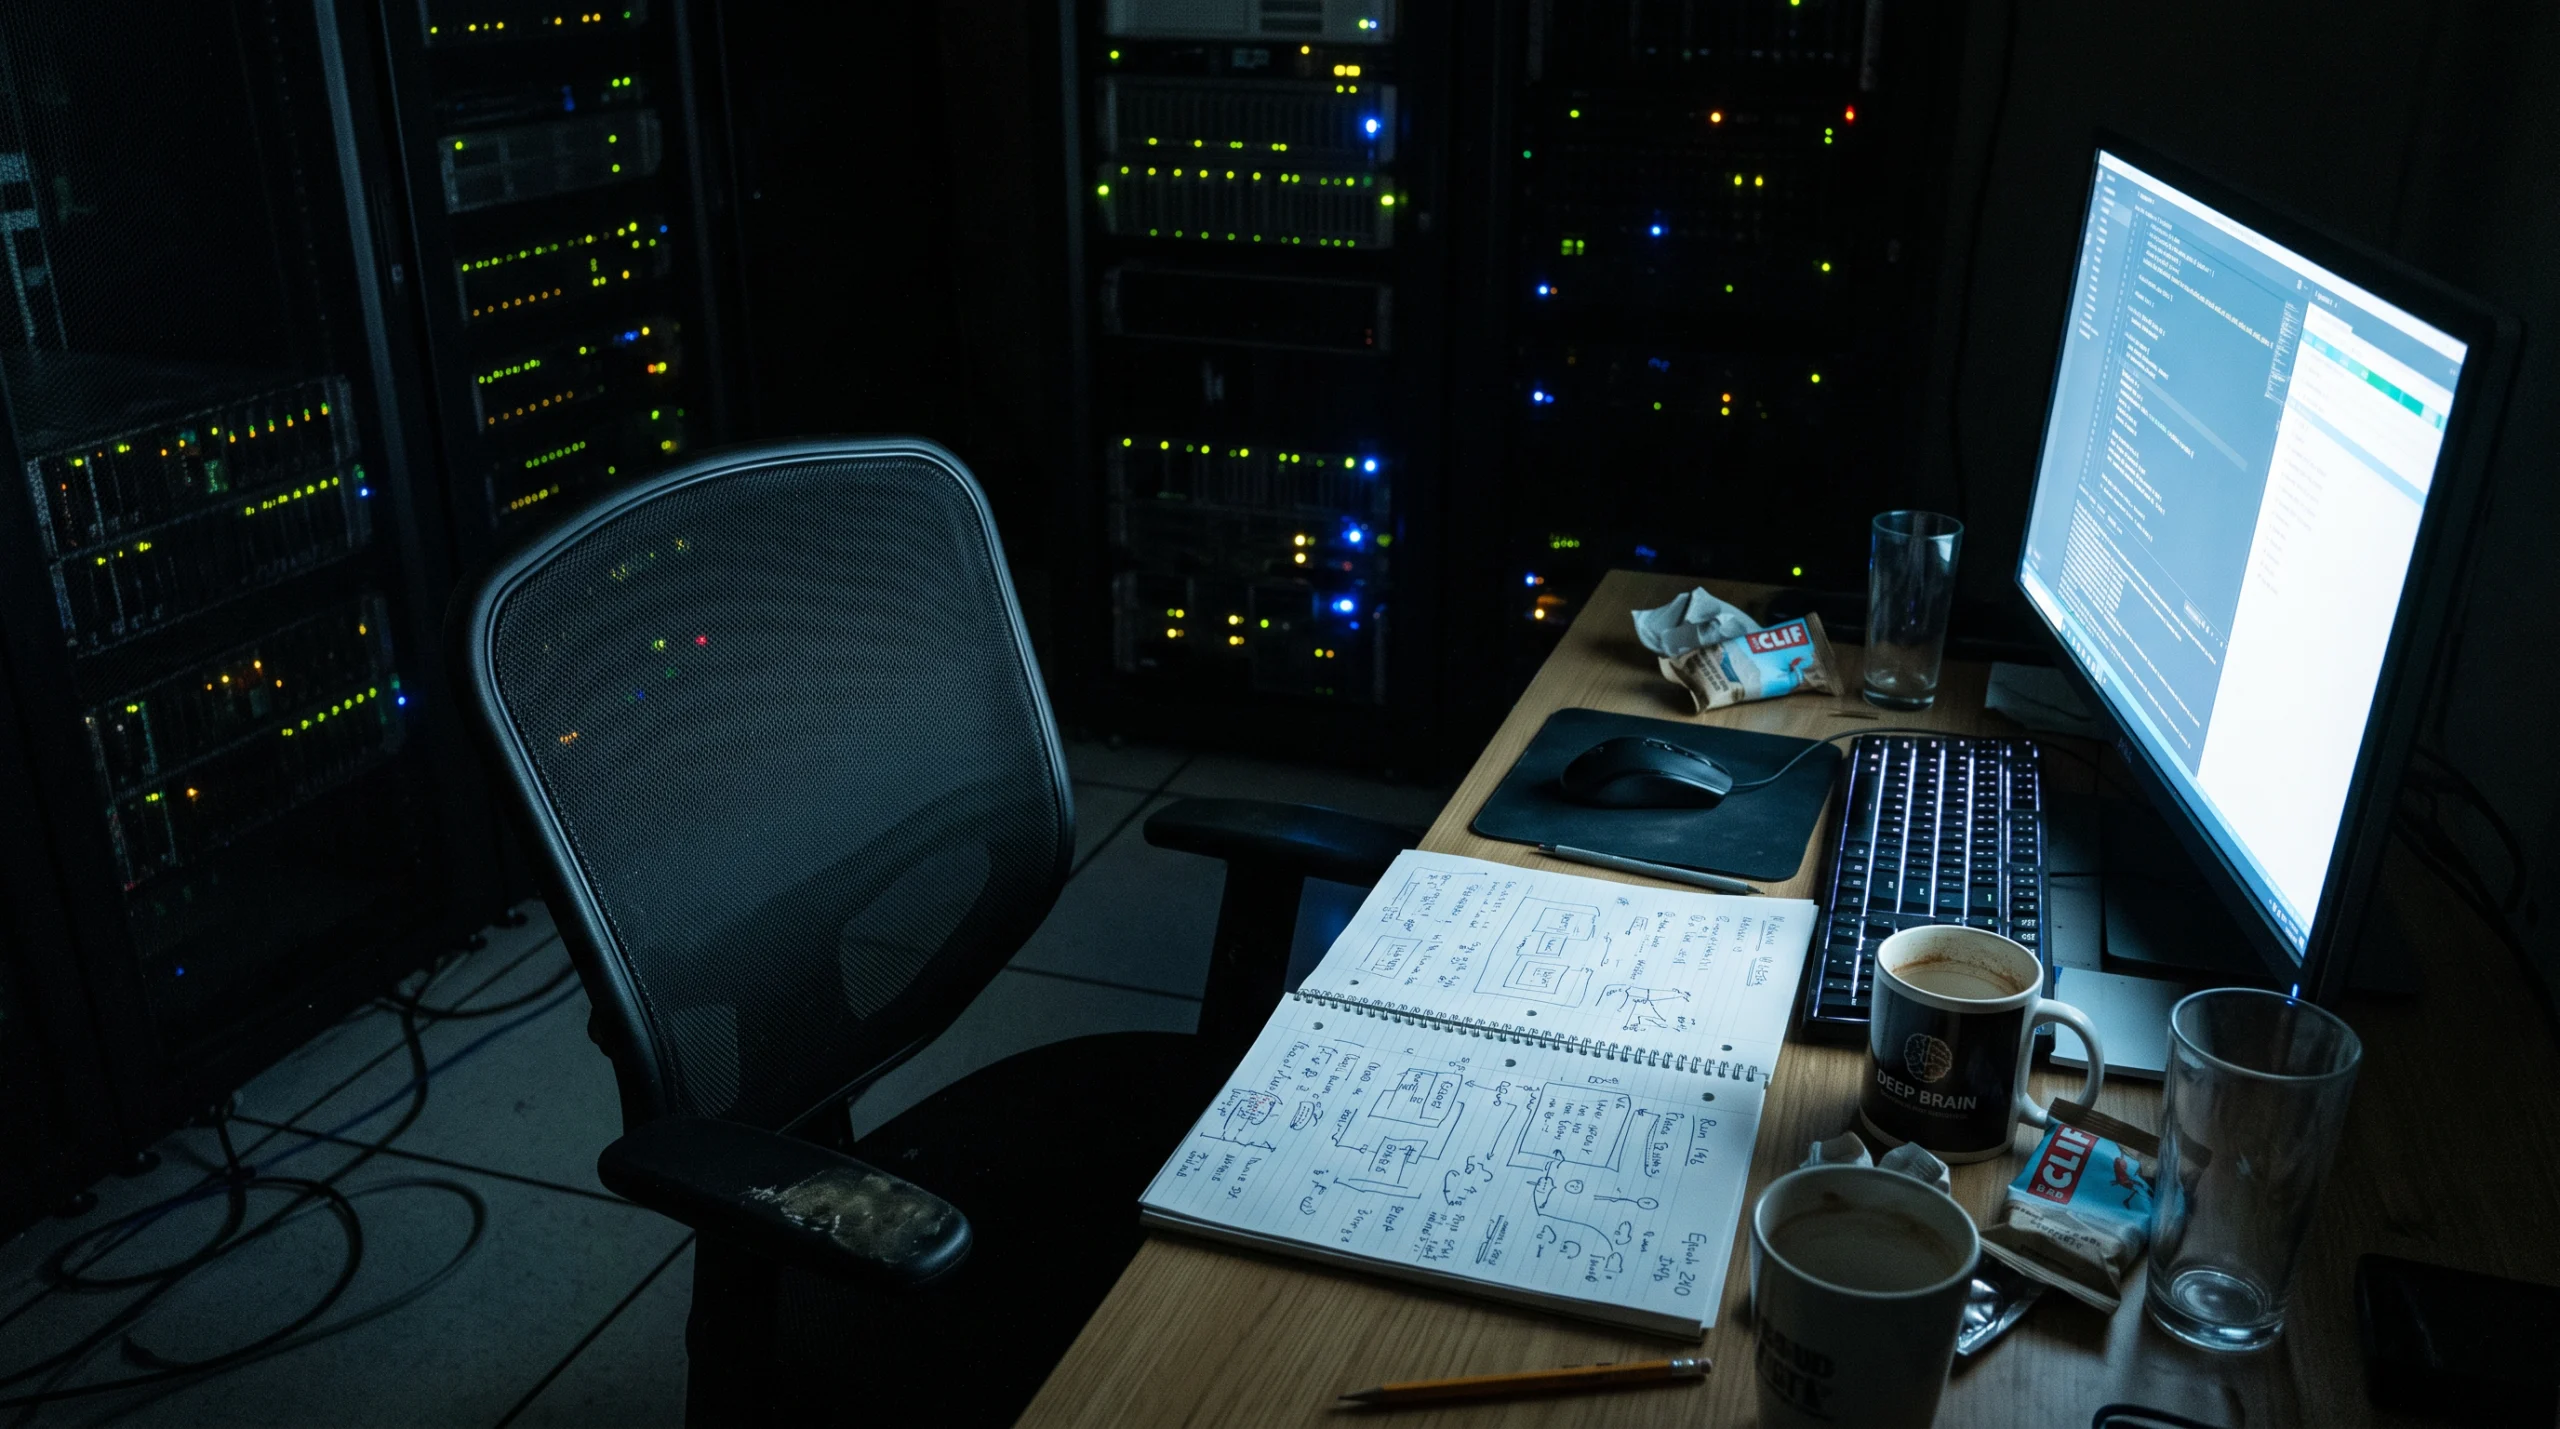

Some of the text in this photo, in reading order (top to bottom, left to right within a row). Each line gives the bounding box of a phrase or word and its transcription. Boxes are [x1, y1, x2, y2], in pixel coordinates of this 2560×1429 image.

[1758, 625, 1802, 650] CLIF
[1876, 1068, 1915, 1099] DEEP
[1919, 1088, 1978, 1110] BRAIN
[1697, 1118, 1717, 1139] Run
[2042, 1127, 2092, 1189] CLIF
